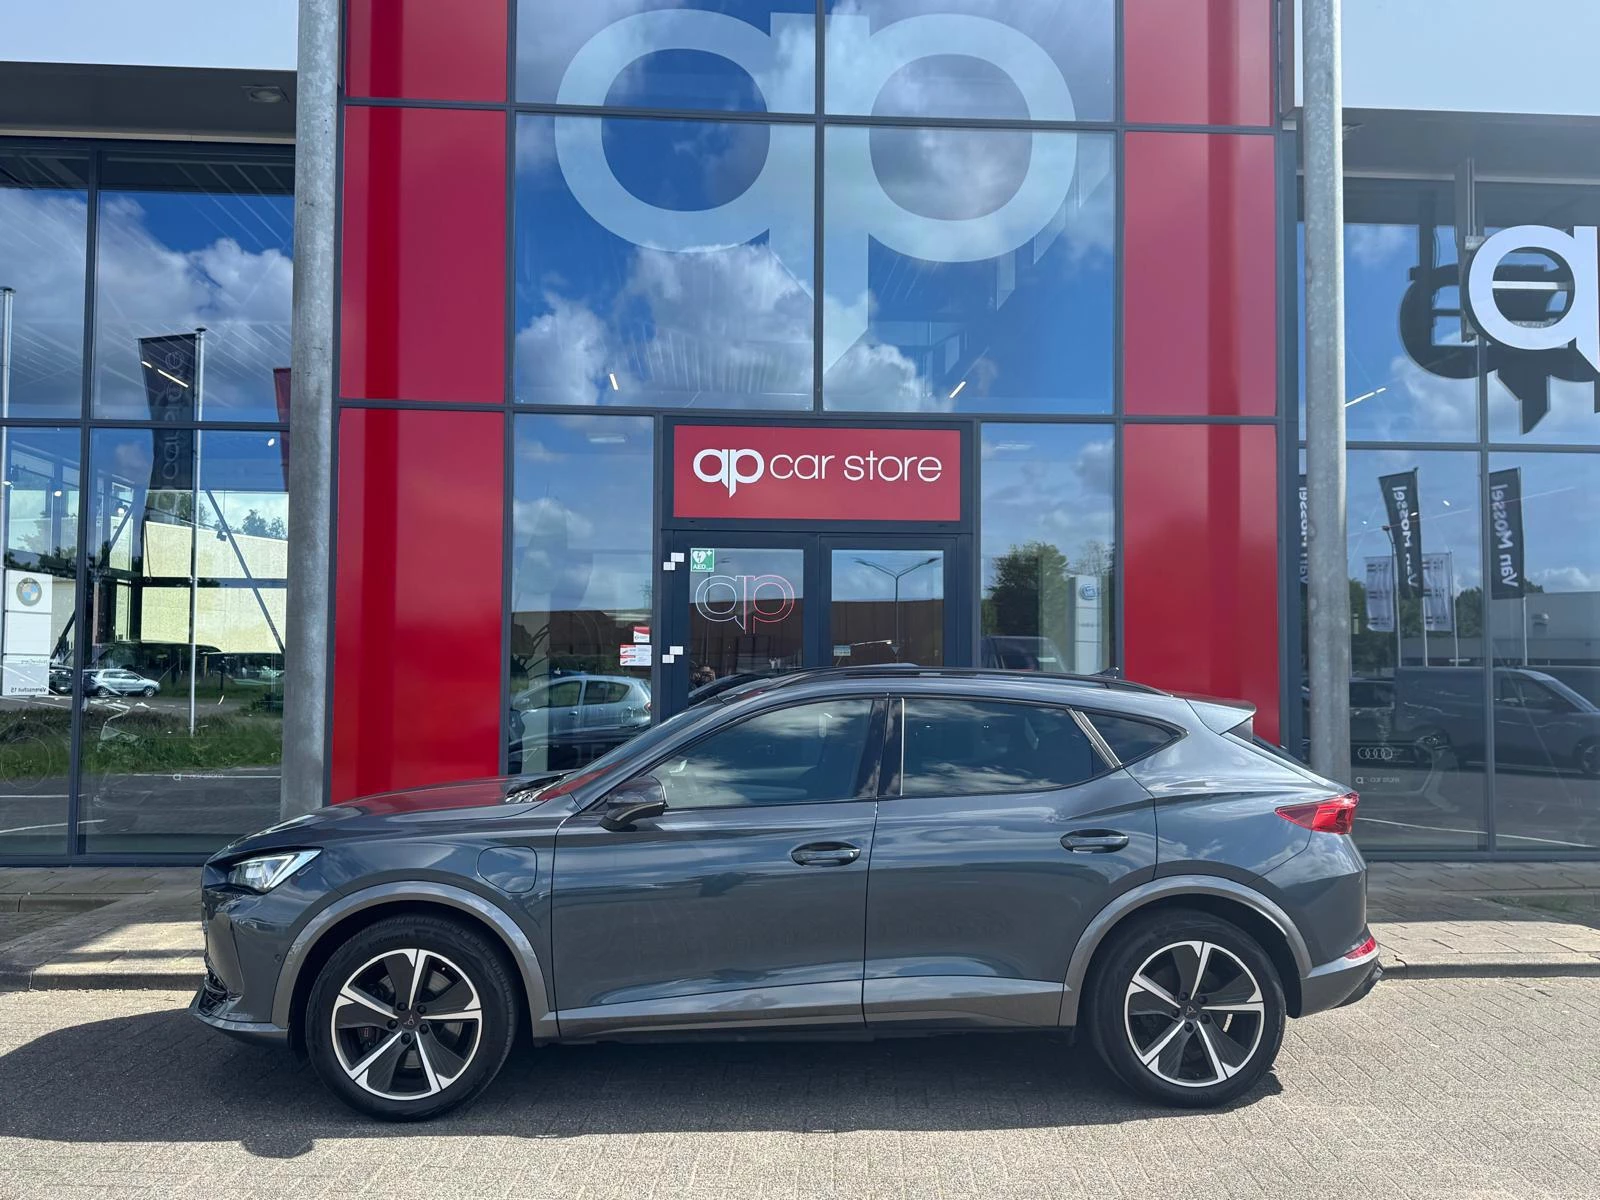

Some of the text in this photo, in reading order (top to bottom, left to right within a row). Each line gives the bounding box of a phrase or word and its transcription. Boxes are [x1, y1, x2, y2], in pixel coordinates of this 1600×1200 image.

[1467, 224, 1600, 374] a
[692, 448, 943, 498] ap car store
[695, 574, 795, 635] ap
